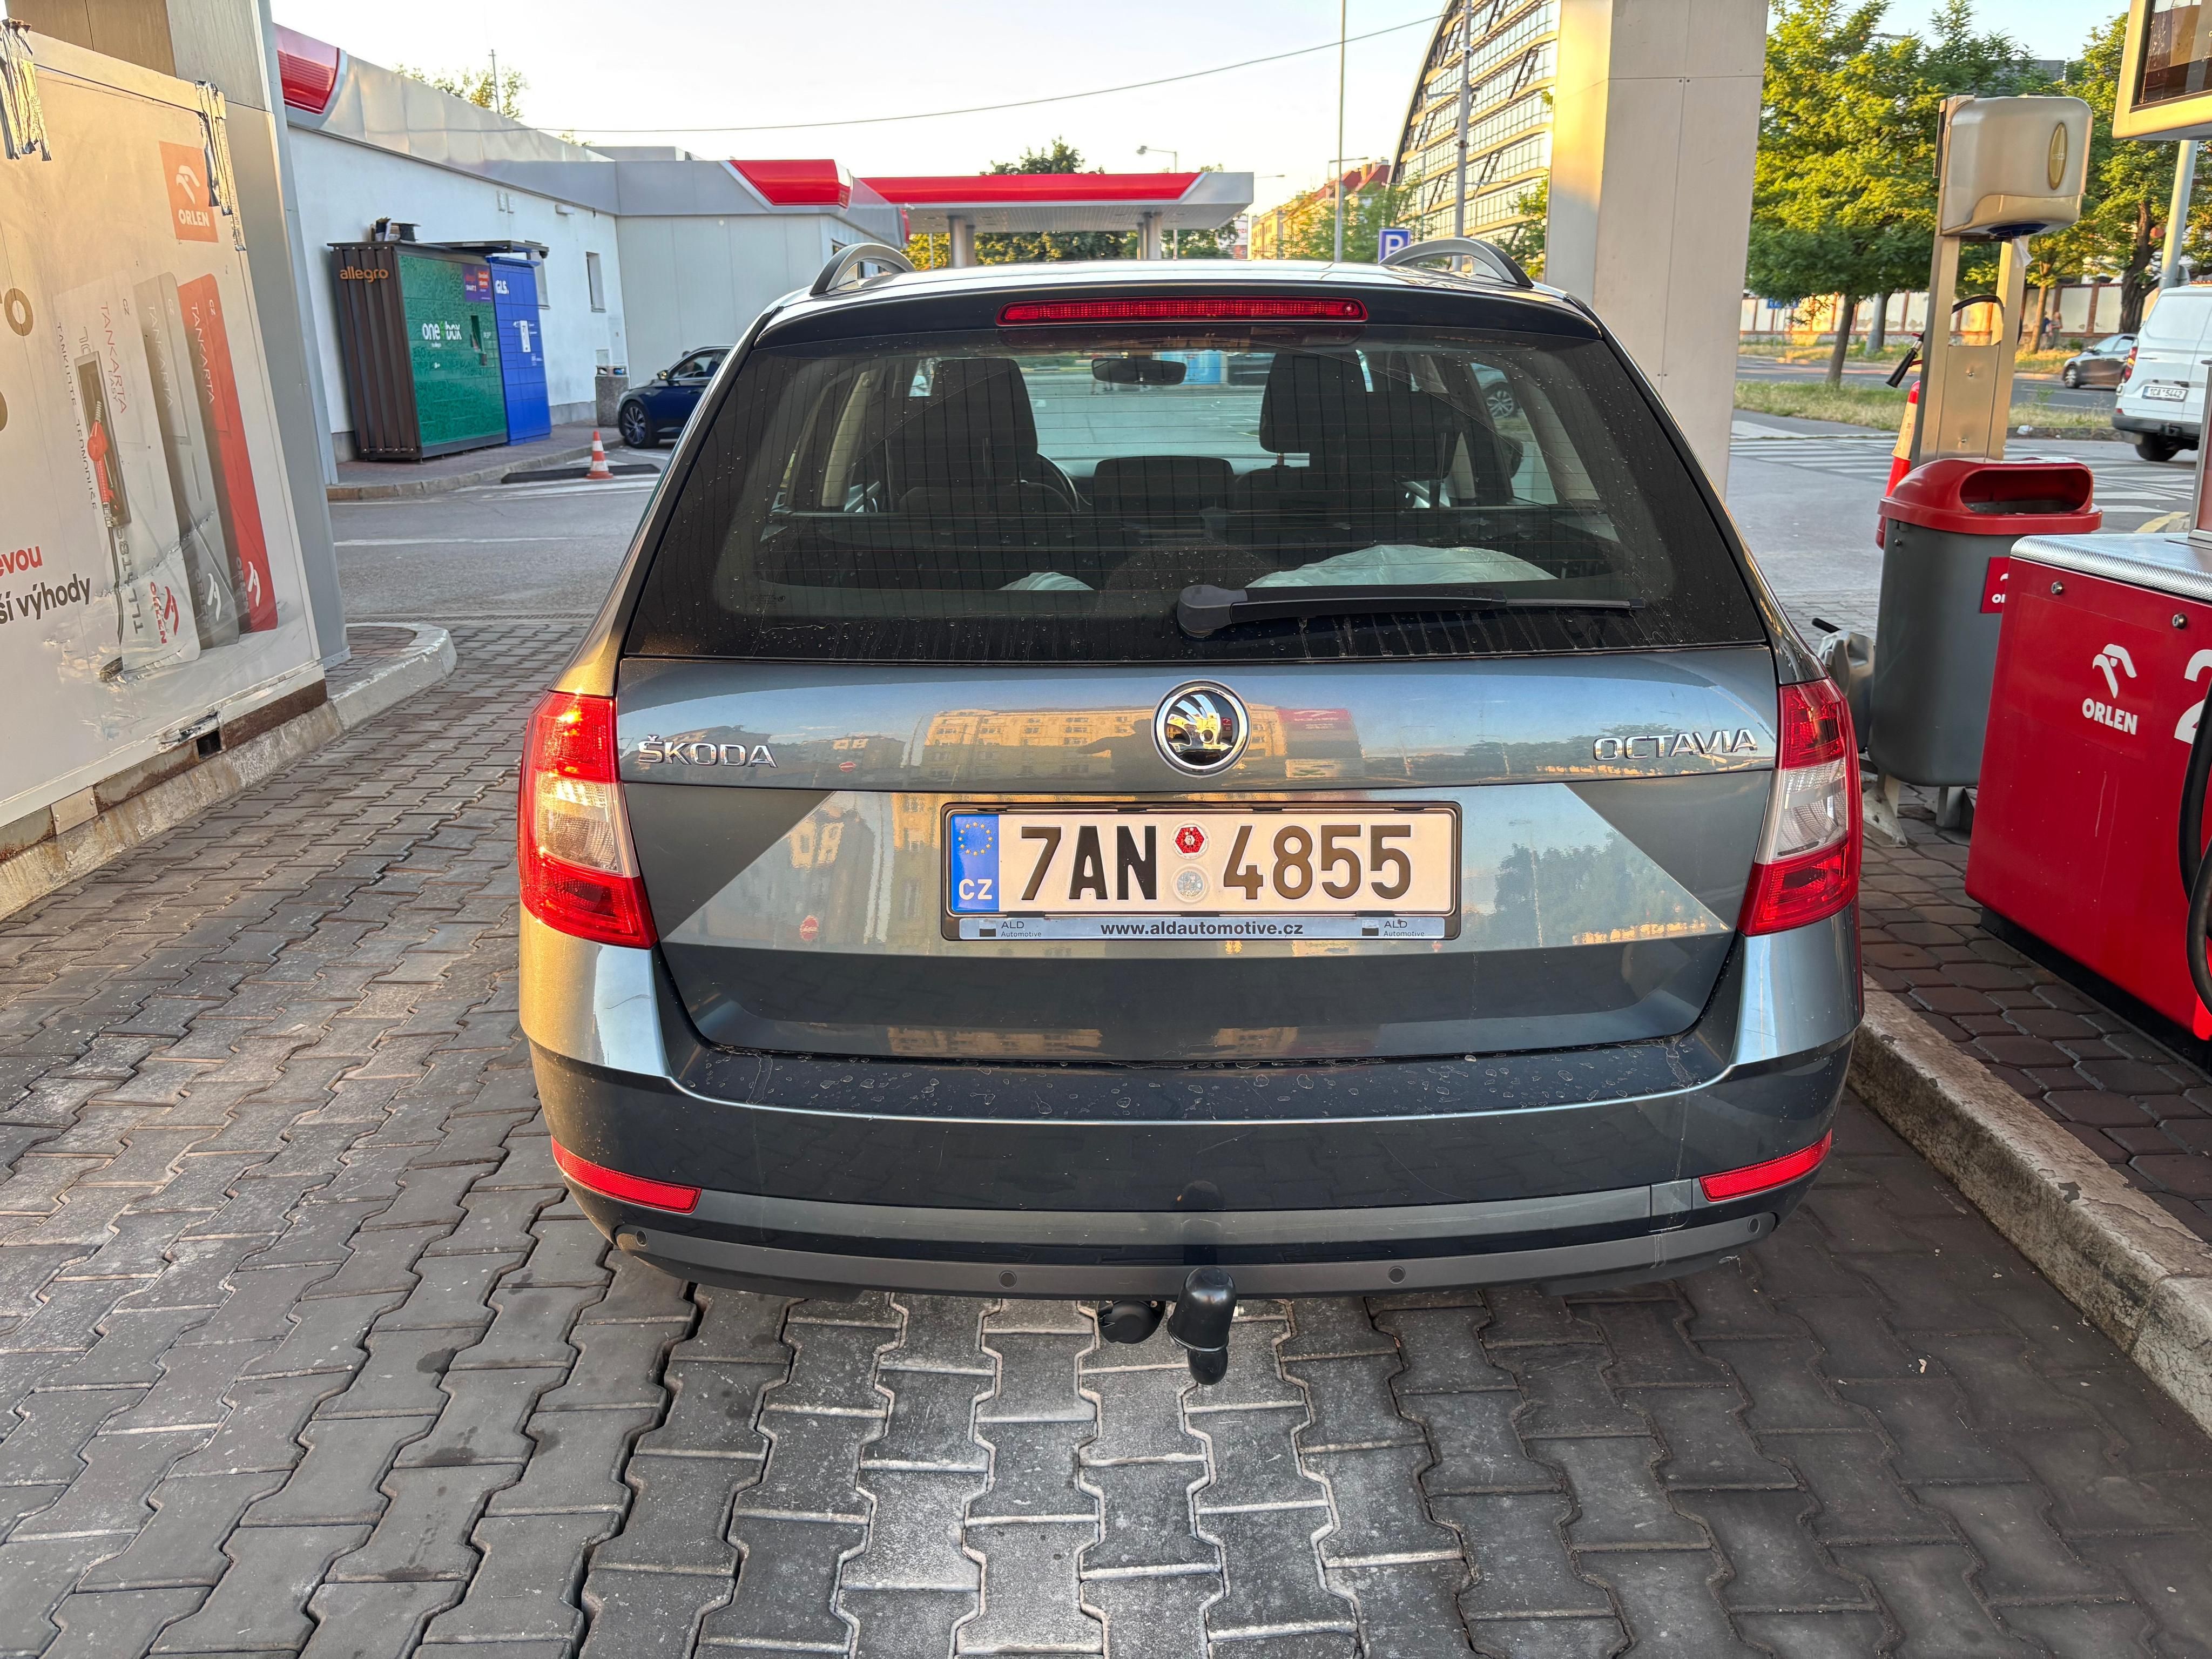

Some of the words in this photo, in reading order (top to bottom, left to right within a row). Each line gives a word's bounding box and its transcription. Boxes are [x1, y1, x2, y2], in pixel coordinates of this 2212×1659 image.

[179, 208, 210, 227] ORLEN
[1385, 235, 1404, 255] P
[340, 266, 389, 283] allegro
[101, 301, 127, 413] TANKARTA
[149, 302, 173, 407] TANKARTA
[191, 302, 215, 404] TANKARTA
[16, 574, 90, 620] výhody
[2174, 649, 2212, 745] 2
[2082, 698, 2137, 735] ORLEN
[637, 734, 778, 768] ŠKODA
[1593, 729, 1758, 761] OCTAVIA
[1021, 826, 1157, 900] 7AN
[1223, 825, 1411, 899] 4855
[959, 879, 992, 900] CZ
[1101, 921, 1303, 935] www.aldautomotive.cz
